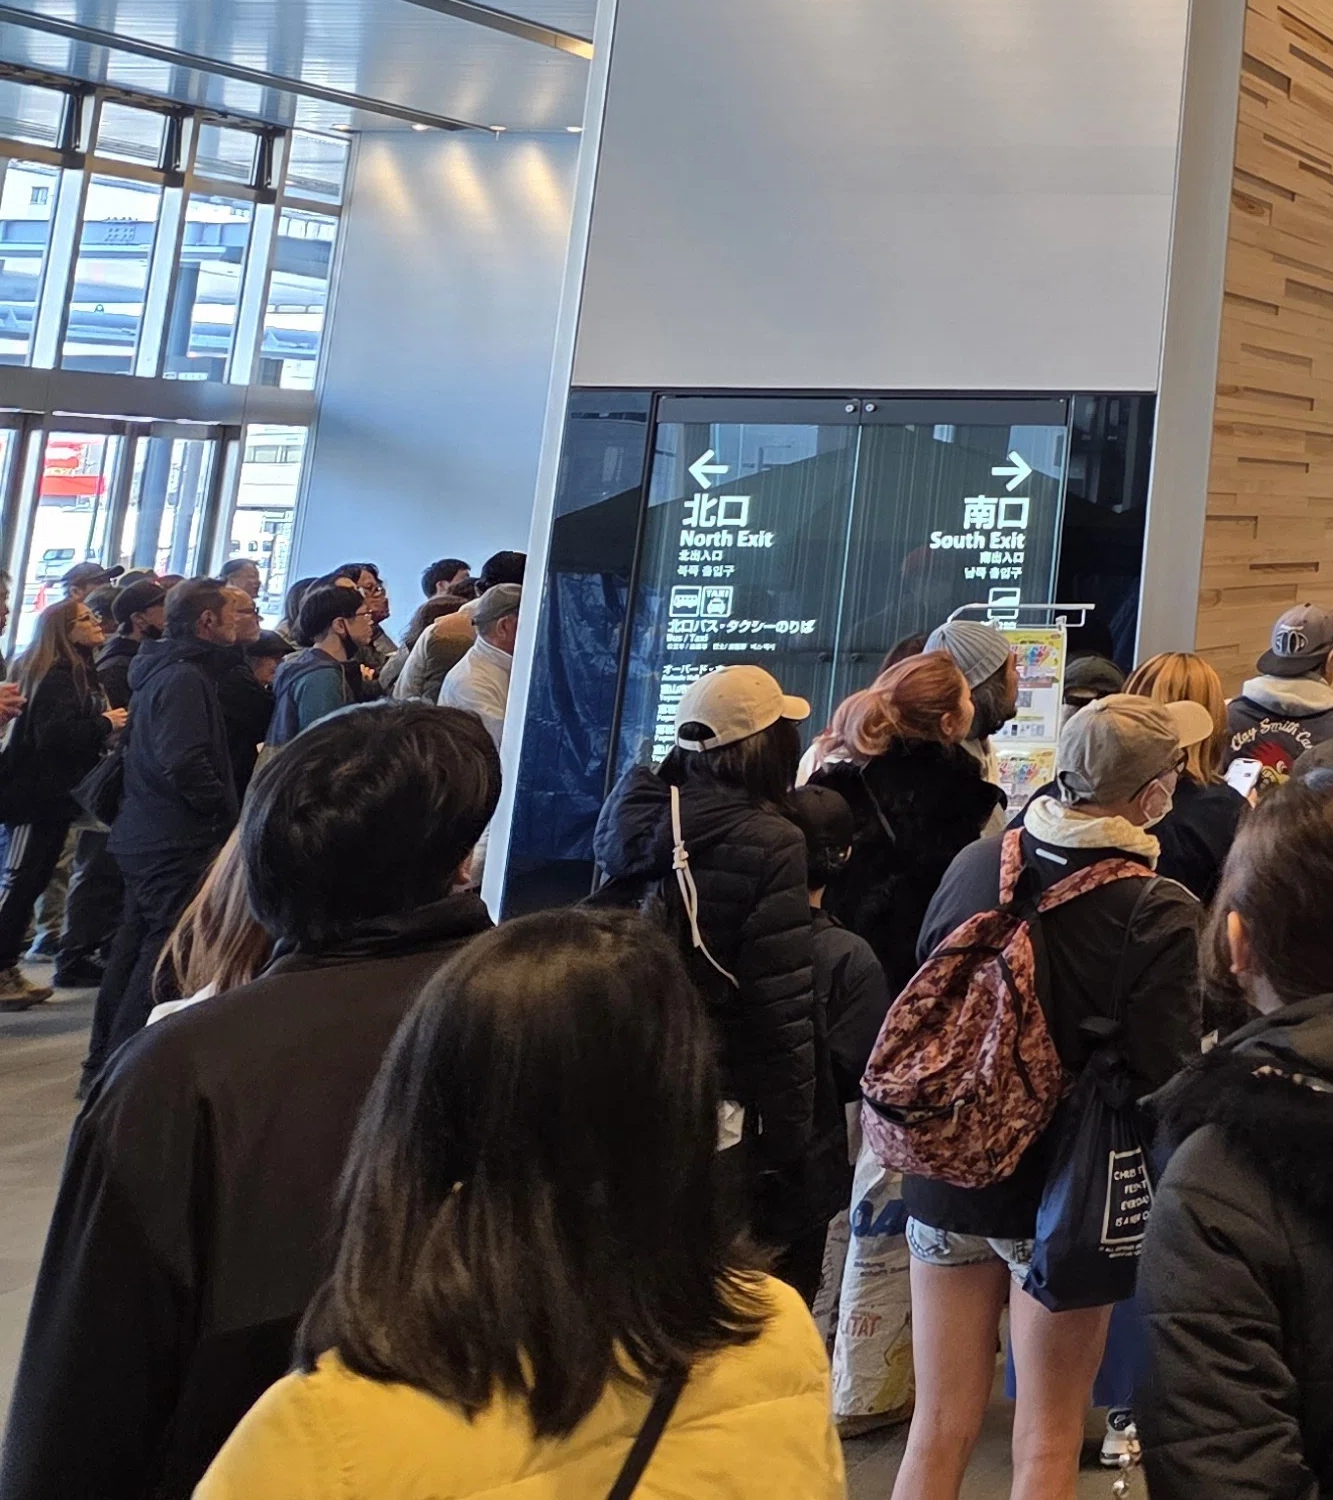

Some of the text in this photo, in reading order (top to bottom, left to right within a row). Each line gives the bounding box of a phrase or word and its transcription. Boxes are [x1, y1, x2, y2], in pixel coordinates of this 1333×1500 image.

[681, 493, 751, 528] 北口
[963, 494, 1030, 530] 南口
[679, 529, 777, 549] North Exit
[929, 531, 1026, 550] South Exit
[678, 549, 723, 562] 北出入口
[979, 551, 1025, 564] 南出入口
[706, 589, 730, 598] TAXI
[667, 618, 817, 635] 北口バス・タクシーのりば
[1230, 727, 1258, 752] Clay
[1259, 717, 1300, 737] Smith
